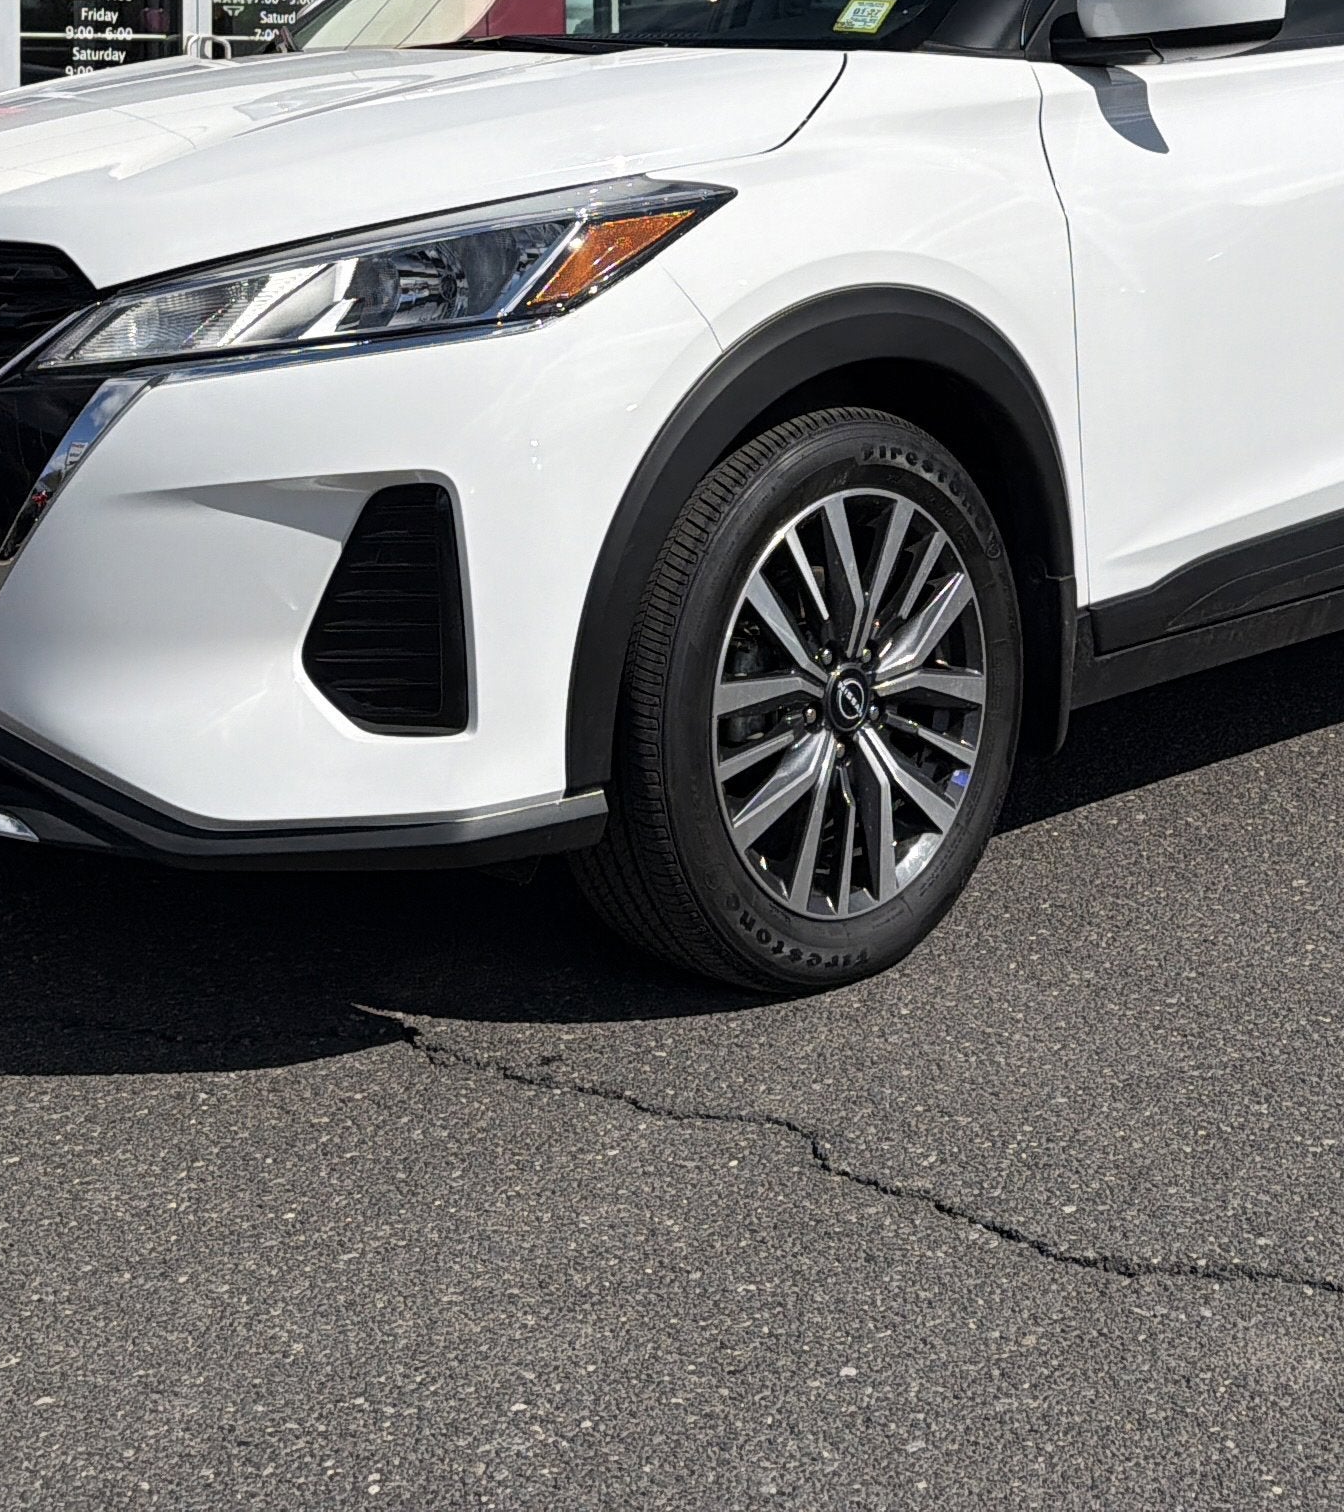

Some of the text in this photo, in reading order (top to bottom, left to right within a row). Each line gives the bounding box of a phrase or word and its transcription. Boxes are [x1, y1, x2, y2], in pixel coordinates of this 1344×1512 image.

[80, 7, 119, 24] Friday
[259, 11, 297, 25] Saturd
[65, 25, 94, 40] 9:00
[105, 27, 134, 41] 6:00
[72, 46, 127, 64] Saturday
